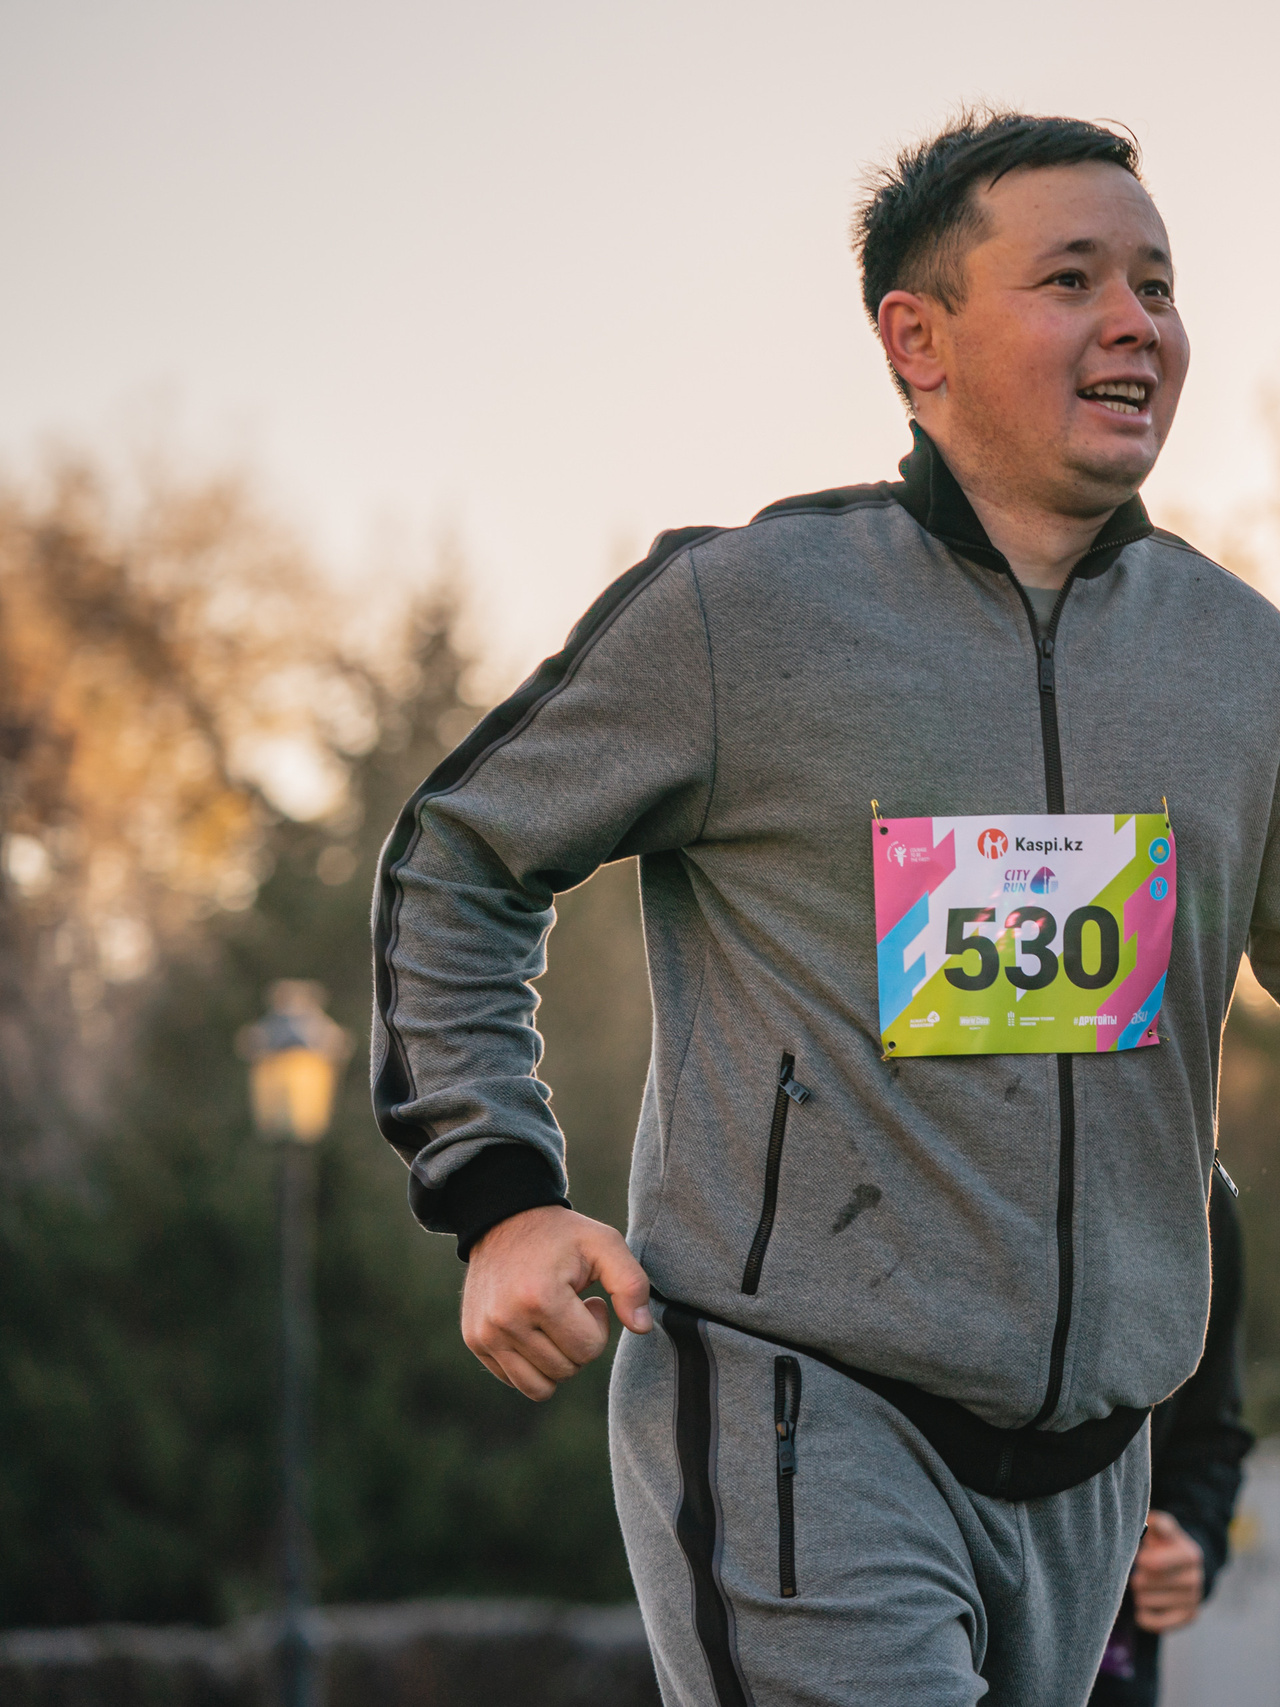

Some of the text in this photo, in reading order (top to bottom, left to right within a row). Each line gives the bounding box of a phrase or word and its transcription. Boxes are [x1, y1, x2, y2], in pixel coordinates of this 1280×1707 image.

[1015, 837, 1083, 855] Kaspi.kz
[1004, 869, 1030, 881] CITY
[1003, 882, 1027, 893] RUN
[944, 905, 1120, 991] 530
[1073, 1014, 1117, 1026] #ДРУГОЙТЫ
